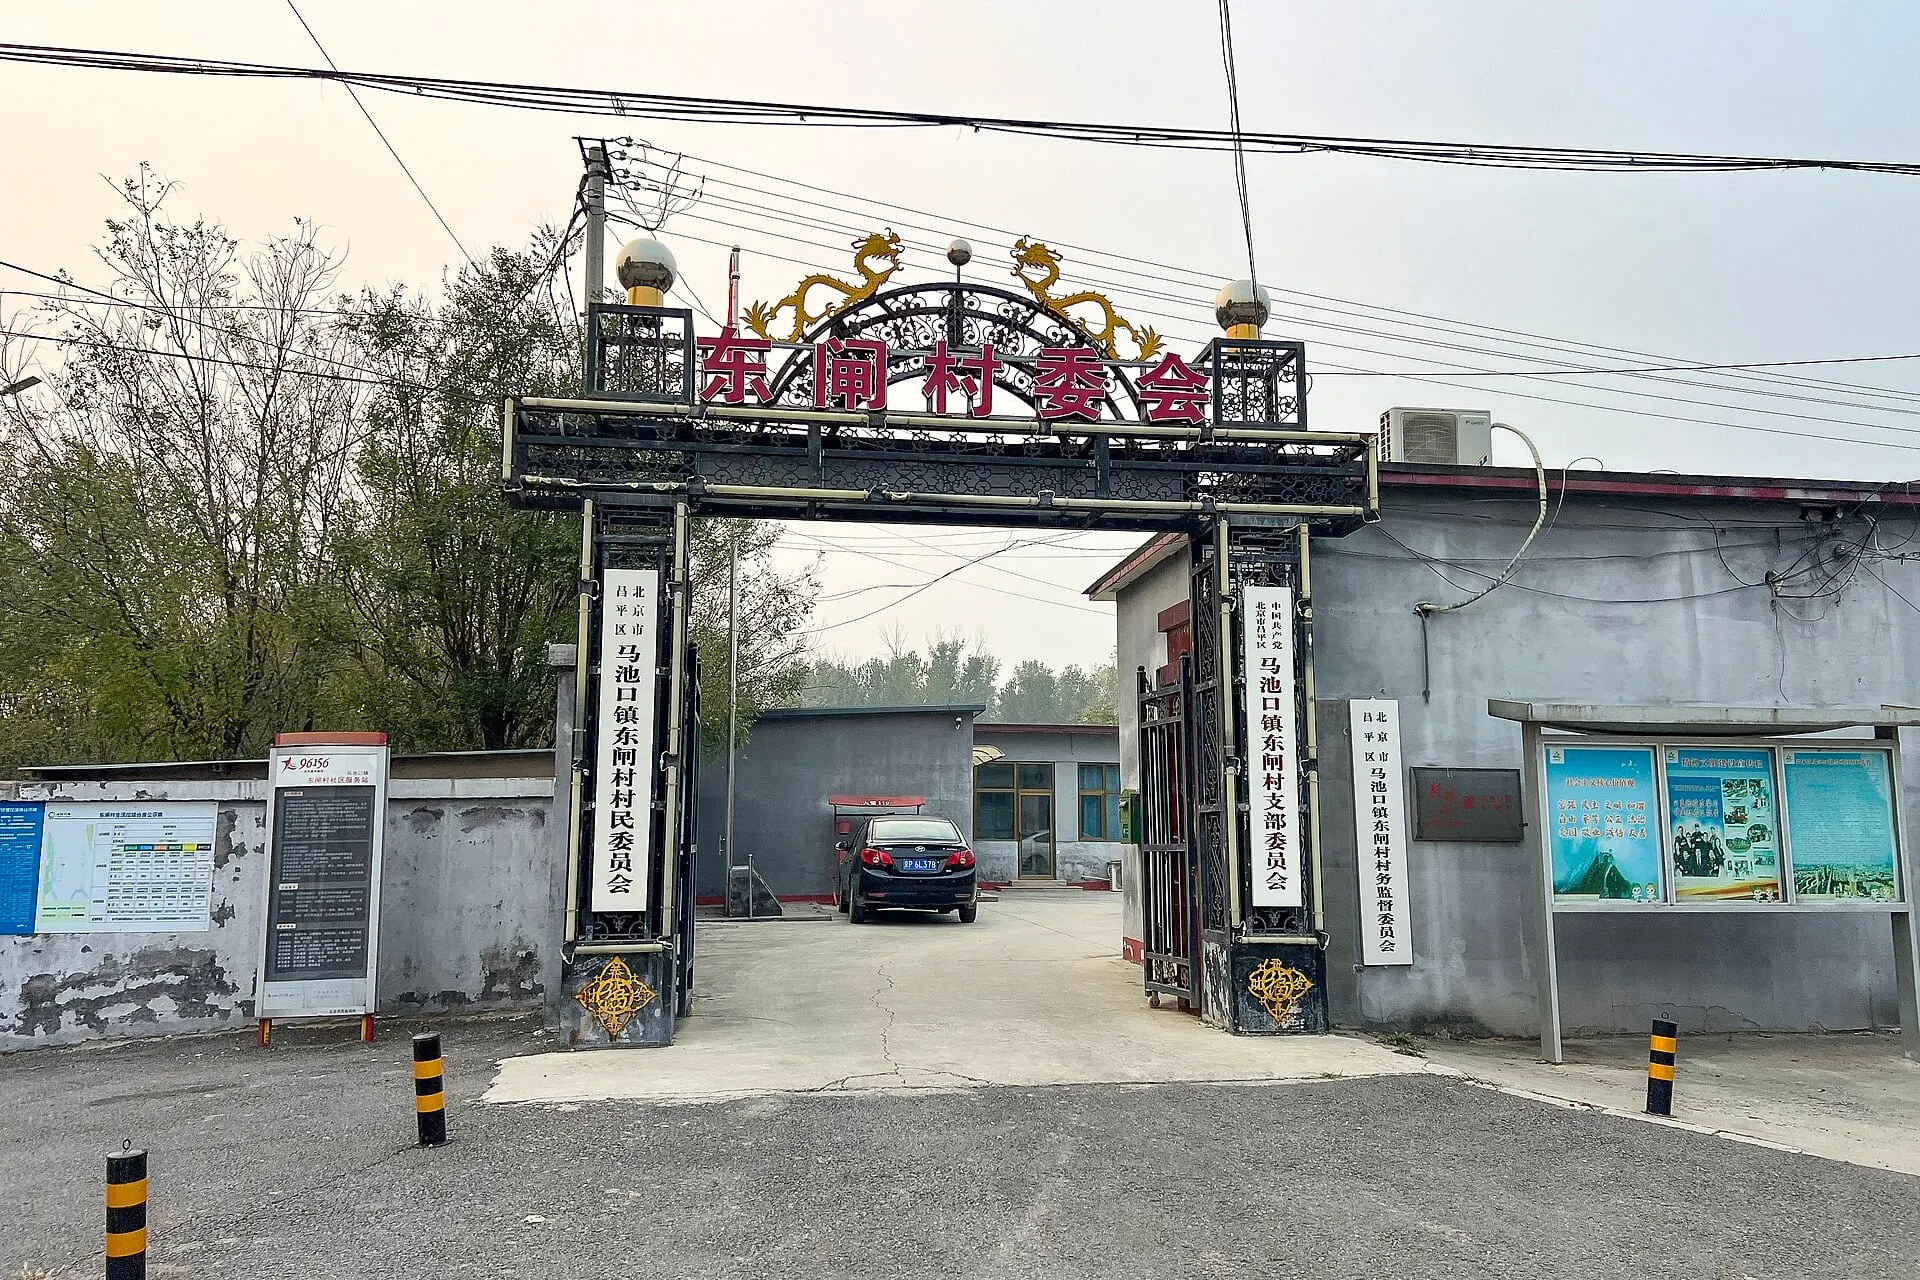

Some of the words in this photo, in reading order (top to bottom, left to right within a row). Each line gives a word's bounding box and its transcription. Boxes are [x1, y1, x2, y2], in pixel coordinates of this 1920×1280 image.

[697, 327, 1209, 423] 东闸村委会
[615, 585, 628, 636] 昌平区
[632, 585, 646, 637] 北京市
[1271, 601, 1283, 650] 中国共产党
[1363, 711, 1375, 763] 昌平区
[1376, 711, 1389, 763] 北京市
[299, 757, 331, 770] 96156
[607, 644, 641, 894] 马池口镇东闸村村民委员会
[1259, 657, 1288, 891] 马池口镇东闸村支部委员会
[1370, 767, 1397, 953] 马池口镇东闸村村务监督委员会
